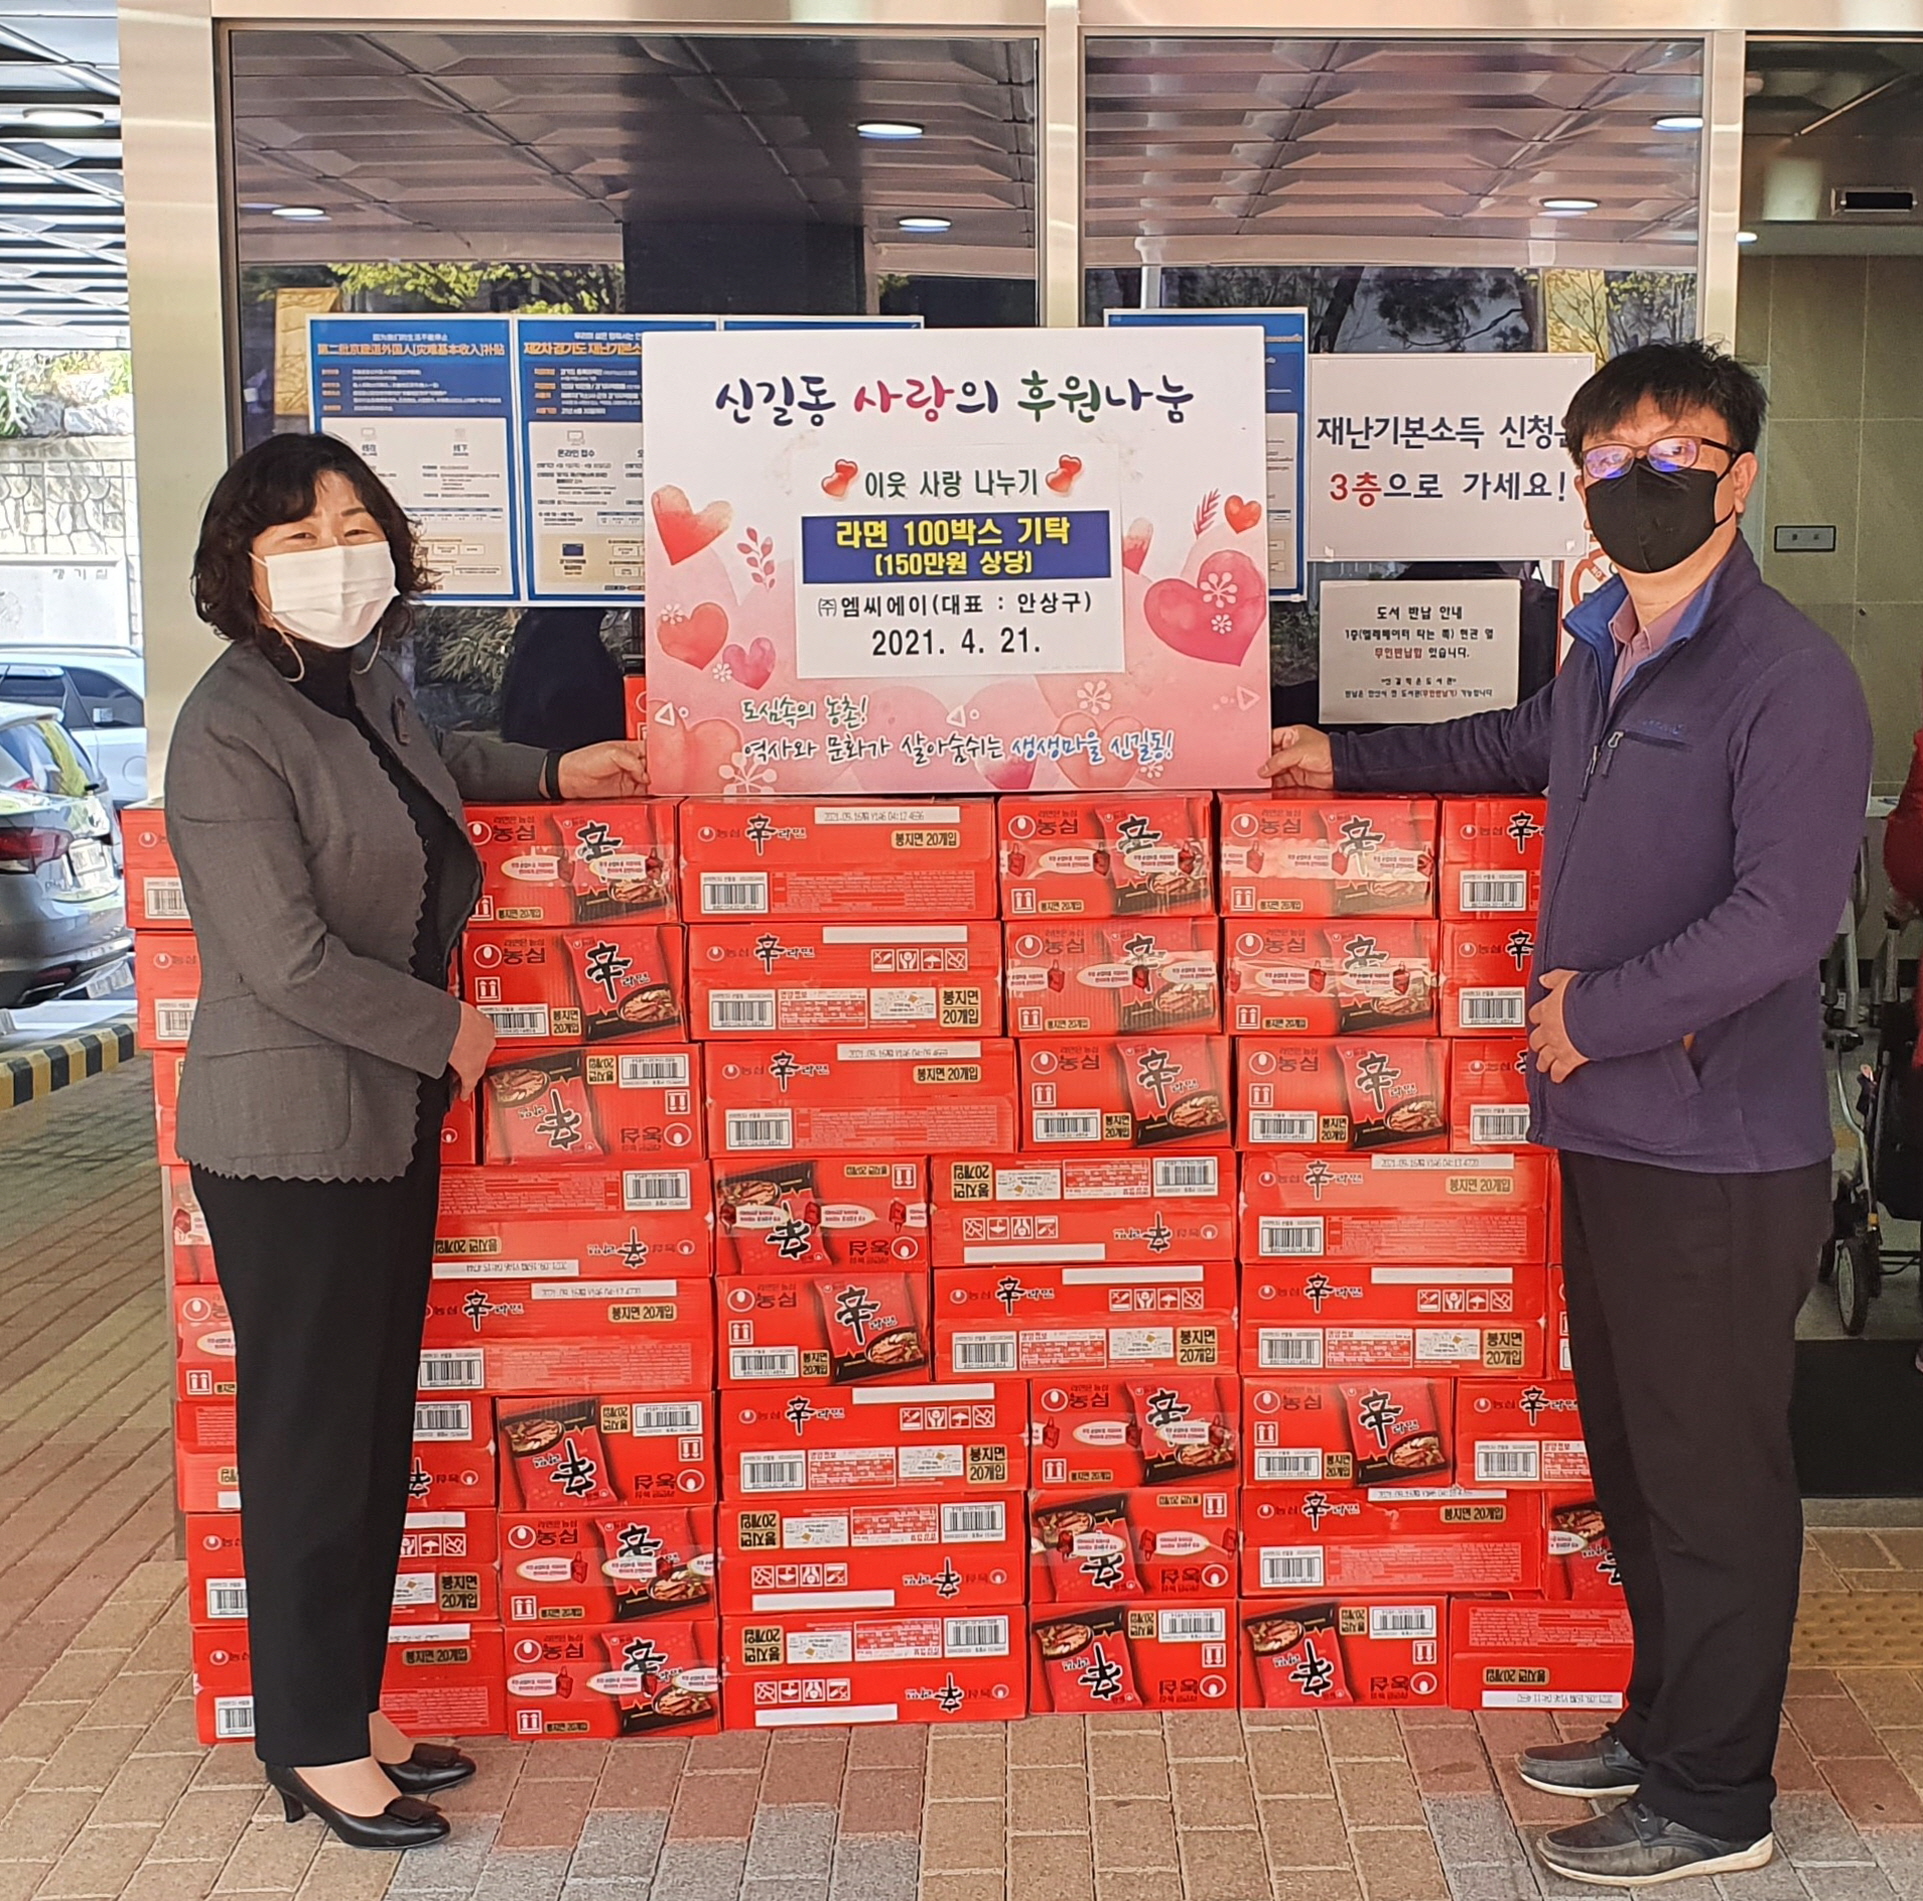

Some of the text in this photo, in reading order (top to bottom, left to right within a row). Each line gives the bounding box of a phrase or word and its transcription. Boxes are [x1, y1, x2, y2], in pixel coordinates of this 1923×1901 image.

[716, 371, 1194, 427] 신길동 사랑의 후원나눔
[1316, 416, 1484, 449] 재난기본소득
[864, 468, 1039, 499] 이웃 사랑 나누기
[1330, 472, 1566, 507] 3층으로 가세요!
[836, 518, 1070, 548] 라면 100박스 기탁
[1017, 591, 1092, 615] 안상구)
[1377, 606, 1462, 620] 도서 반납 안내
[872, 627, 1041, 656] 2021. 4. 21.
[742, 697, 869, 726] 도심속의 농촌!
[743, 730, 1174, 766] 역사와 문화가 살아숨쉬는 생생마을 신길동!
[493, 824, 535, 842] 농심
[1037, 819, 1078, 835] 농심
[1261, 818, 1301, 835] 농심
[895, 832, 956, 846] 봉지면 20개입
[1044, 938, 1085, 954] 농심
[1265, 938, 1306, 954] 농심
[503, 949, 545, 965] 농심
[587, 942, 631, 1001] 辛
[943, 991, 978, 1005] 봉지면
[553, 1010, 578, 1022] 봉지면
[943, 1008, 978, 1025] 20개입
[553, 1023, 579, 1033] 20개입
[1059, 1055, 1100, 1071] 농심
[1279, 1056, 1318, 1072] 농심
[918, 1067, 978, 1082] 봉지면 20개입
[1138, 1050, 1181, 1108] 辛
[1356, 1053, 1399, 1111] 辛
[1105, 1115, 1130, 1126] 봉지면
[1321, 1119, 1347, 1129] 봉지면
[1105, 1127, 1130, 1138] 20개입
[1321, 1130, 1346, 1141] 20개입
[954, 1164, 989, 1179] 20개입
[954, 1183, 989, 1198] 봉지면
[1450, 1178, 1510, 1192] 봉지면 20개입
[850, 1240, 889, 1255] 농심
[757, 1292, 796, 1308] 농심
[612, 1306, 673, 1320] 봉지면 20개입
[837, 1287, 879, 1343] 辛
[1180, 1329, 1215, 1344] 봉지면
[1487, 1333, 1522, 1347] 봉지면
[803, 1353, 828, 1364] 봉지면
[1180, 1347, 1216, 1363] 20개입
[1486, 1351, 1522, 1365] 20개입
[803, 1364, 828, 1376] 20개입
[1070, 1393, 1109, 1409] 농심
[1282, 1396, 1322, 1411] 농심
[1360, 1390, 1402, 1447] 辛
[970, 1448, 1005, 1462] 봉지면
[1327, 1455, 1350, 1466] 봉지면
[970, 1465, 1005, 1480] 20개입
[1326, 1467, 1350, 1478] 20개입
[635, 1475, 675, 1489] 농심
[741, 1513, 776, 1528] 20개입
[1445, 1506, 1503, 1521] 봉지면 20개입
[537, 1530, 578, 1545] 농심
[741, 1532, 776, 1547] 봉지면
[442, 1576, 477, 1590] 봉지면
[1161, 1569, 1200, 1583] 농심
[442, 1593, 477, 1609] 20개입
[745, 1628, 780, 1643] 20개입
[406, 1649, 468, 1664] 봉지면 20개입
[543, 1644, 584, 1660] 농심
[745, 1648, 780, 1662] 봉지면
[1486, 1669, 1546, 1682] 봉지면 20개입
[1160, 1680, 1198, 1694] 농심
[1371, 1676, 1408, 1691] 농심
